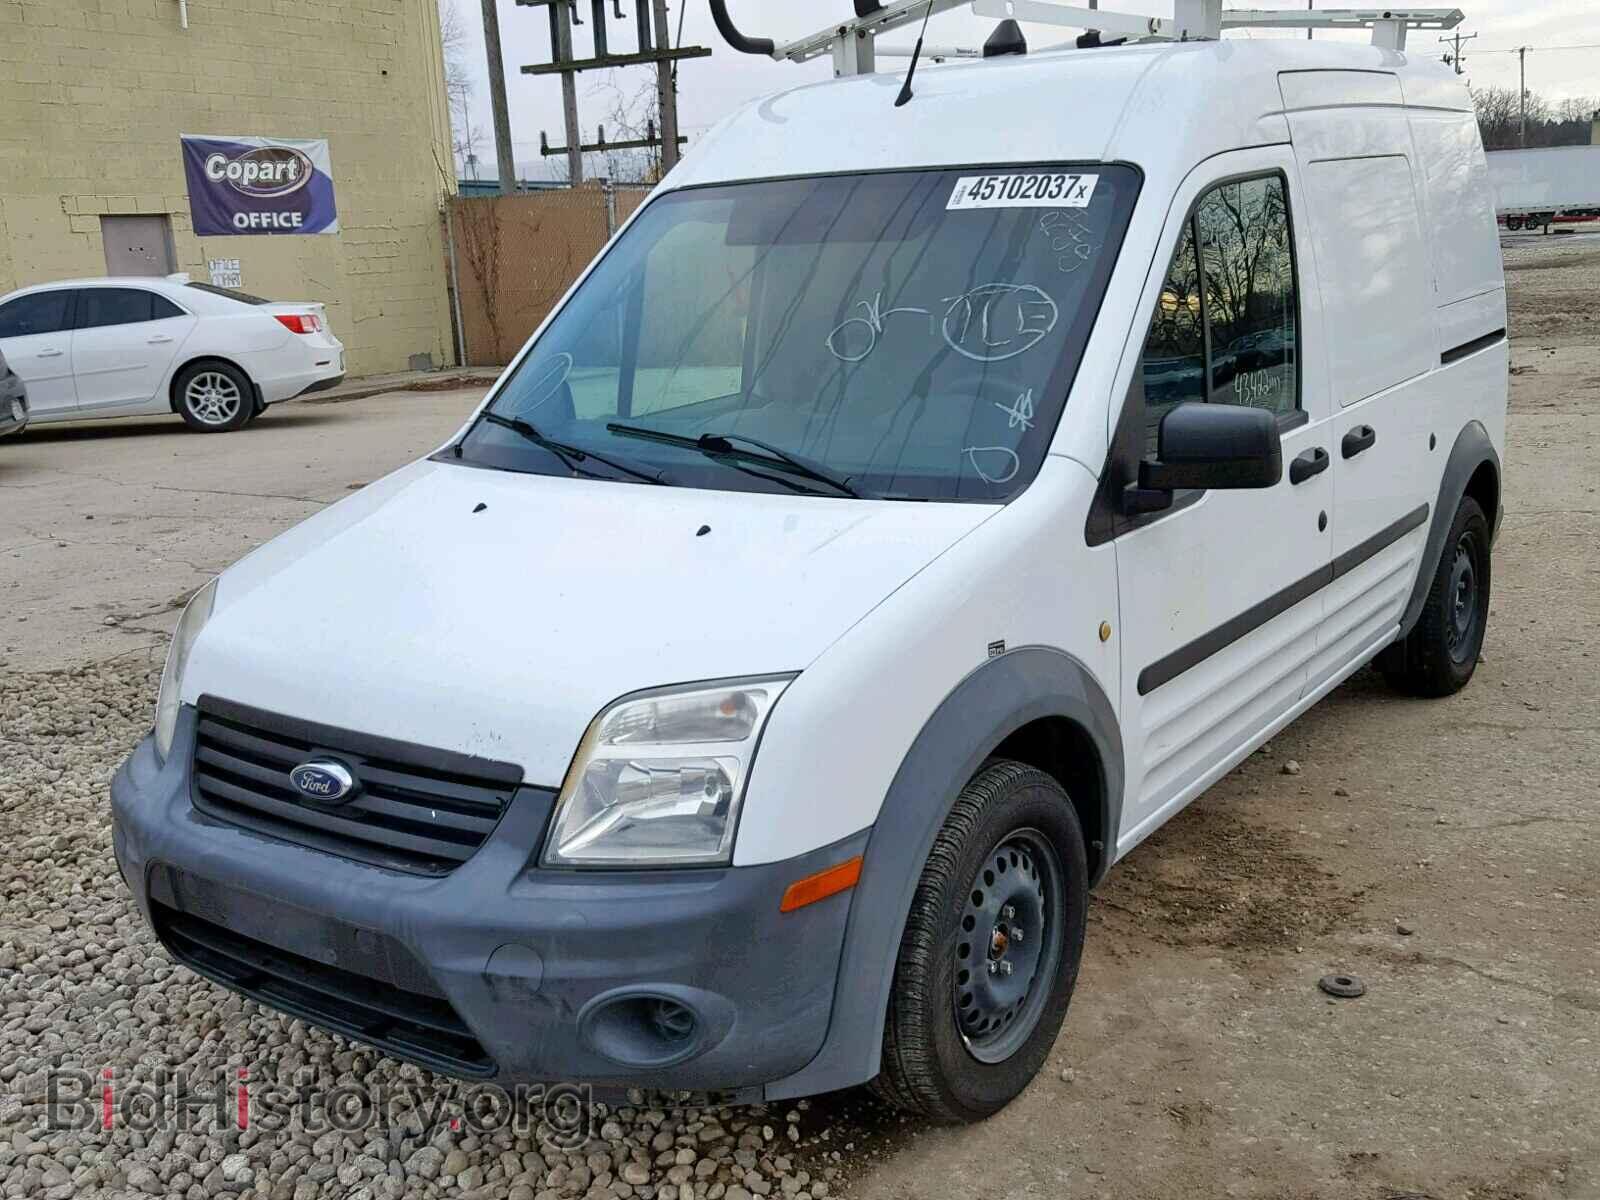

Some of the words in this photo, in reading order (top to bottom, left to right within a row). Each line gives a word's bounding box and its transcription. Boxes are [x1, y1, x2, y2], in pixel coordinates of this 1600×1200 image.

[205, 153, 299, 186] Copart
[232, 212, 303, 228] OFFICE
[300, 771, 331, 794] Ford
